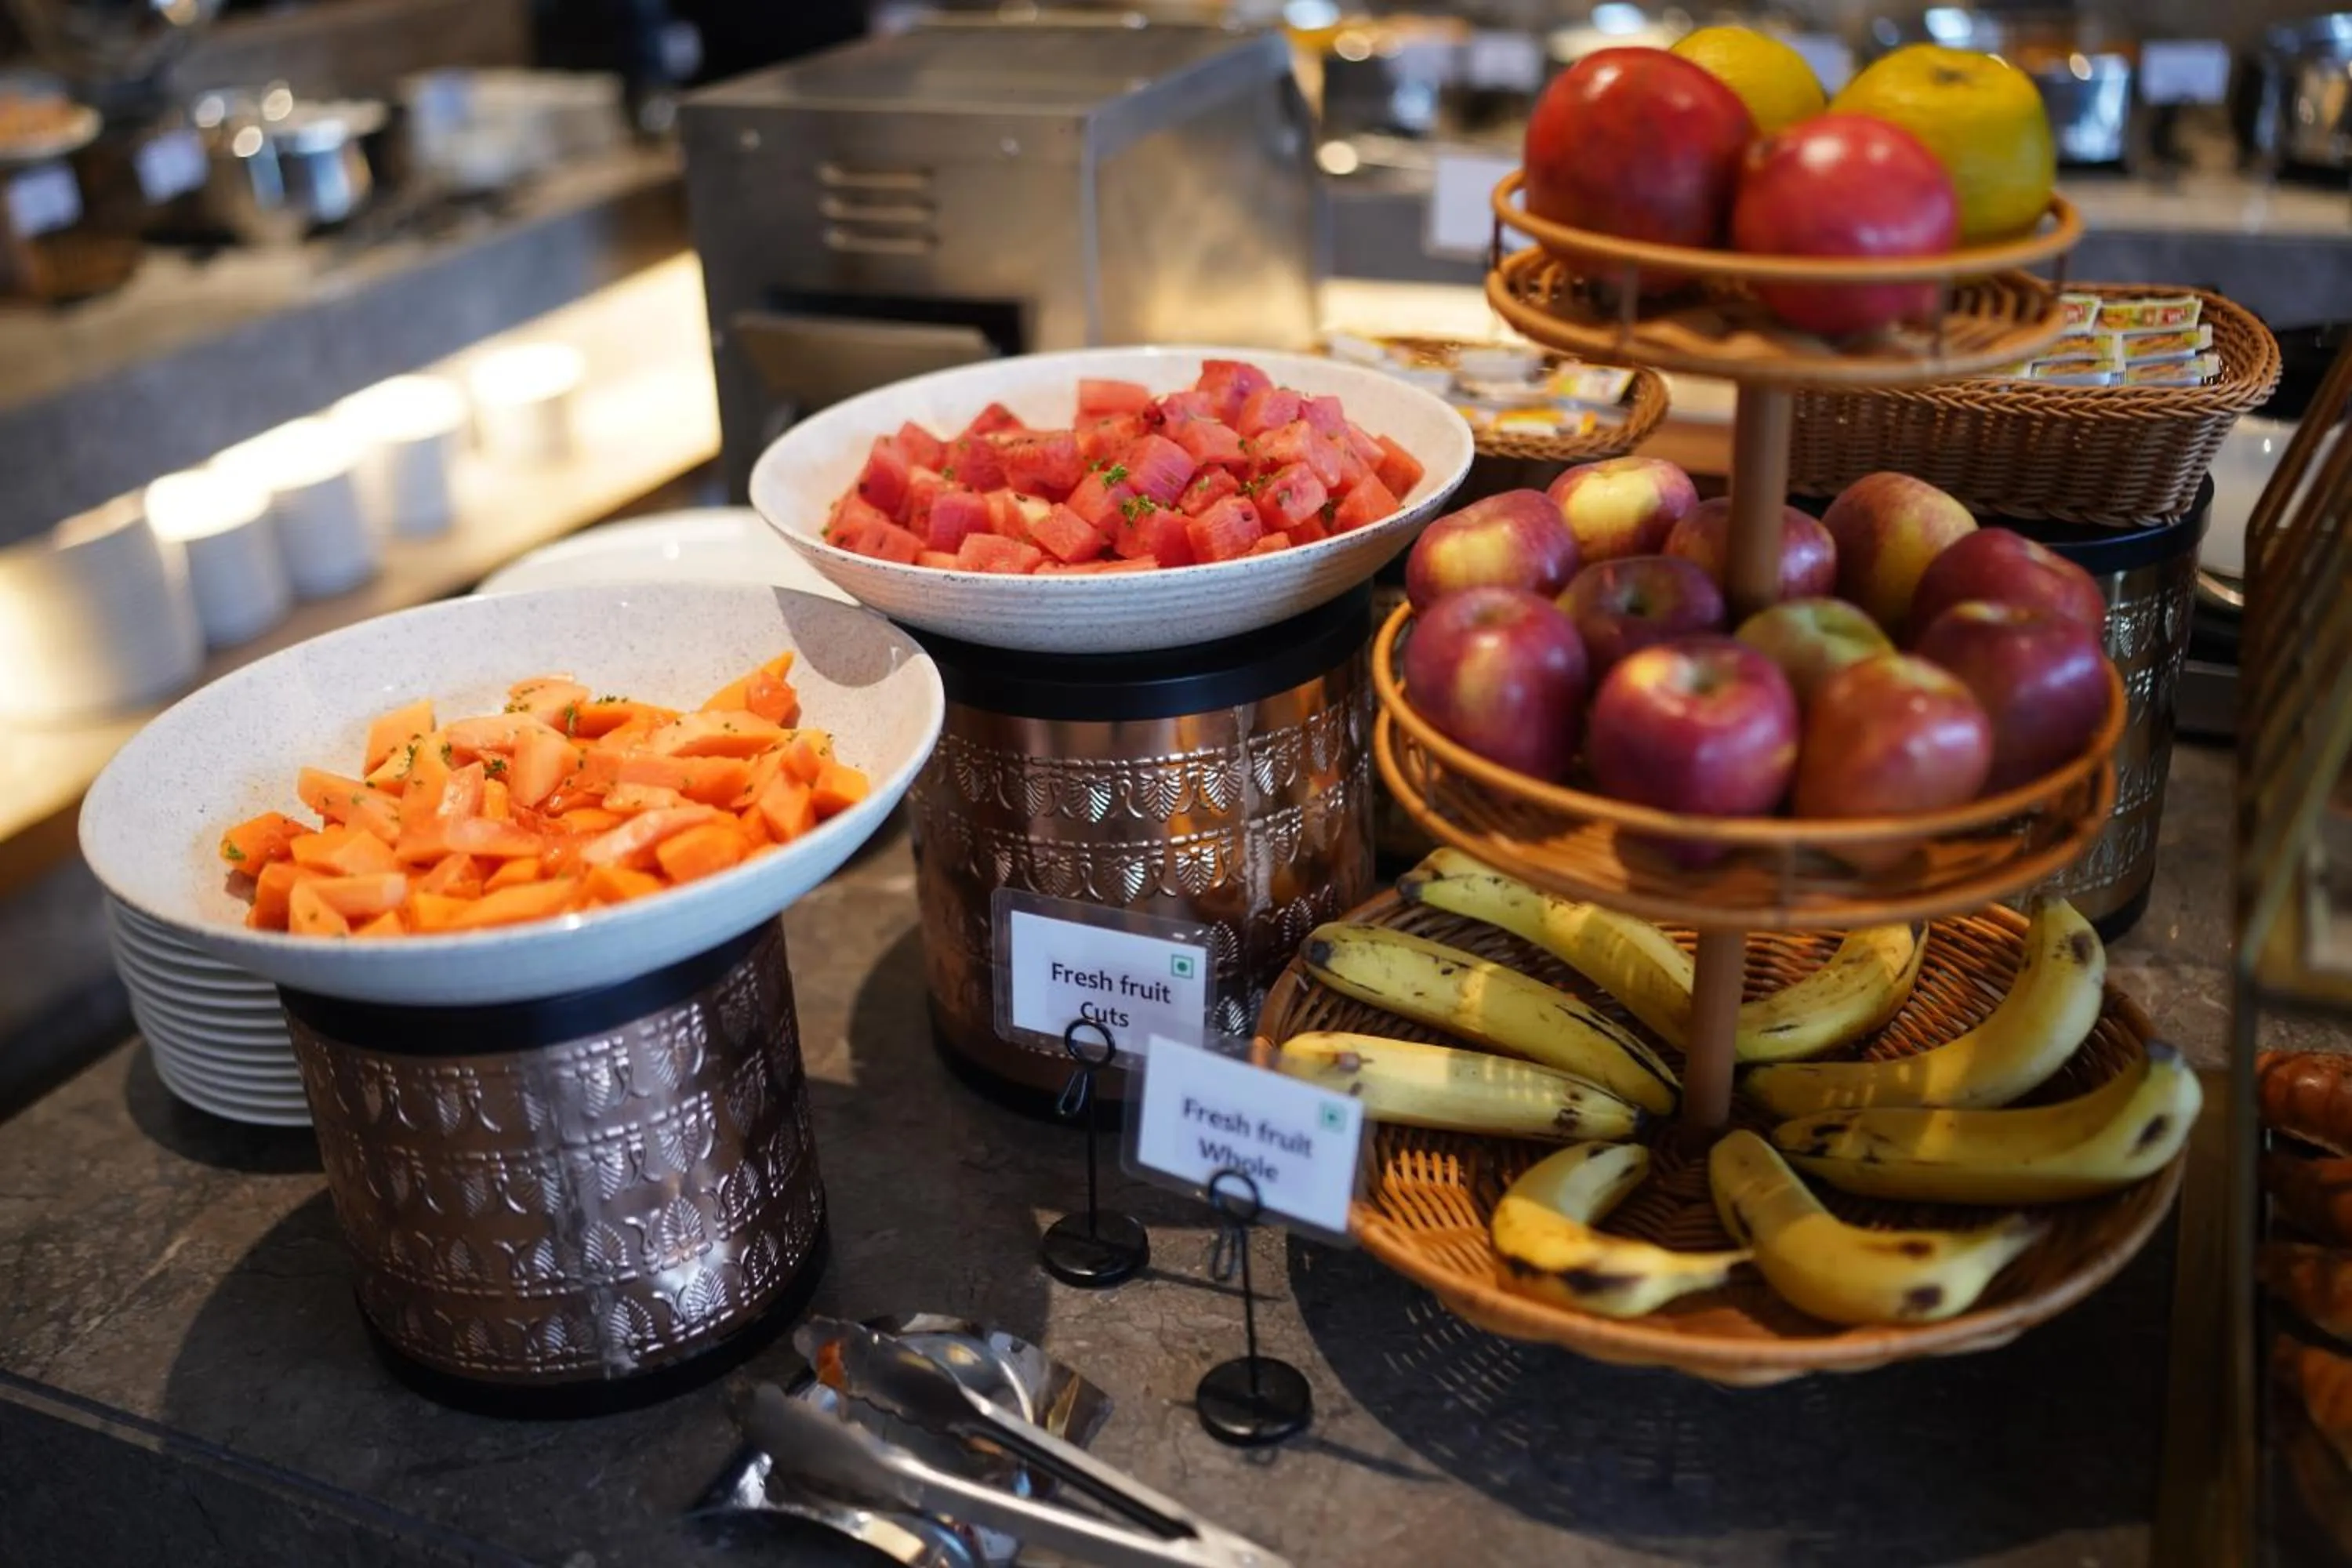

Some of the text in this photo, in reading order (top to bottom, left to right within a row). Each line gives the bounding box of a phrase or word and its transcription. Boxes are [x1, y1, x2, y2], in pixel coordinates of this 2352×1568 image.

[1051, 961, 1171, 1004] Fresh fruit
[1080, 1000, 1130, 1028] Cuts
[1183, 1096, 1313, 1160] Fresh fruit
[1198, 1136, 1279, 1183] Whole
